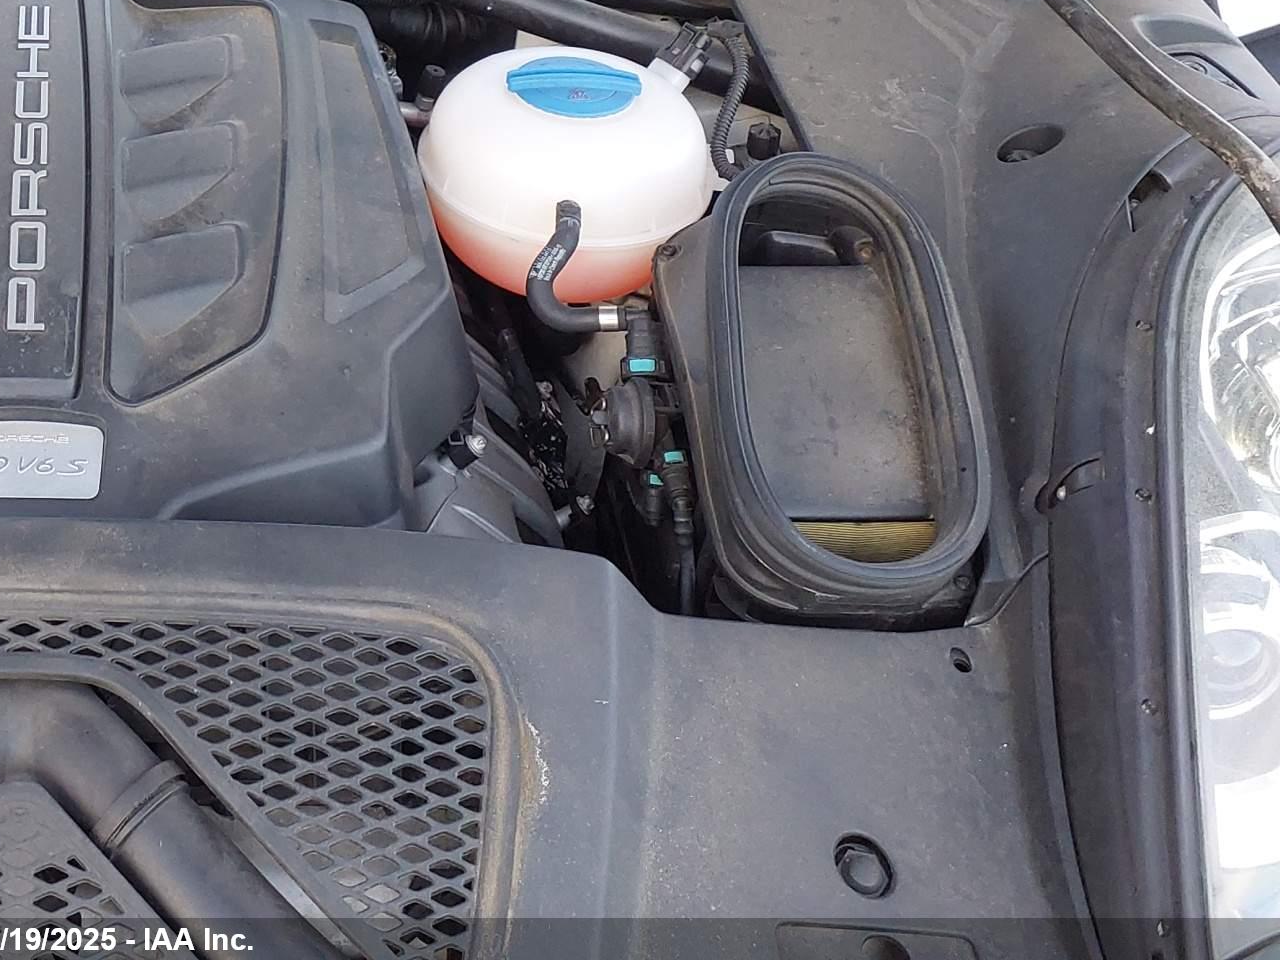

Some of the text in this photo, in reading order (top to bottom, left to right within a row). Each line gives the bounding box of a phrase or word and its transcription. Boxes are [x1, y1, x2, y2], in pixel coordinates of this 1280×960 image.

[6, 5, 51, 332] PORSCHE
[17, 456, 56, 476] V6
[56, 459, 89, 476] S
